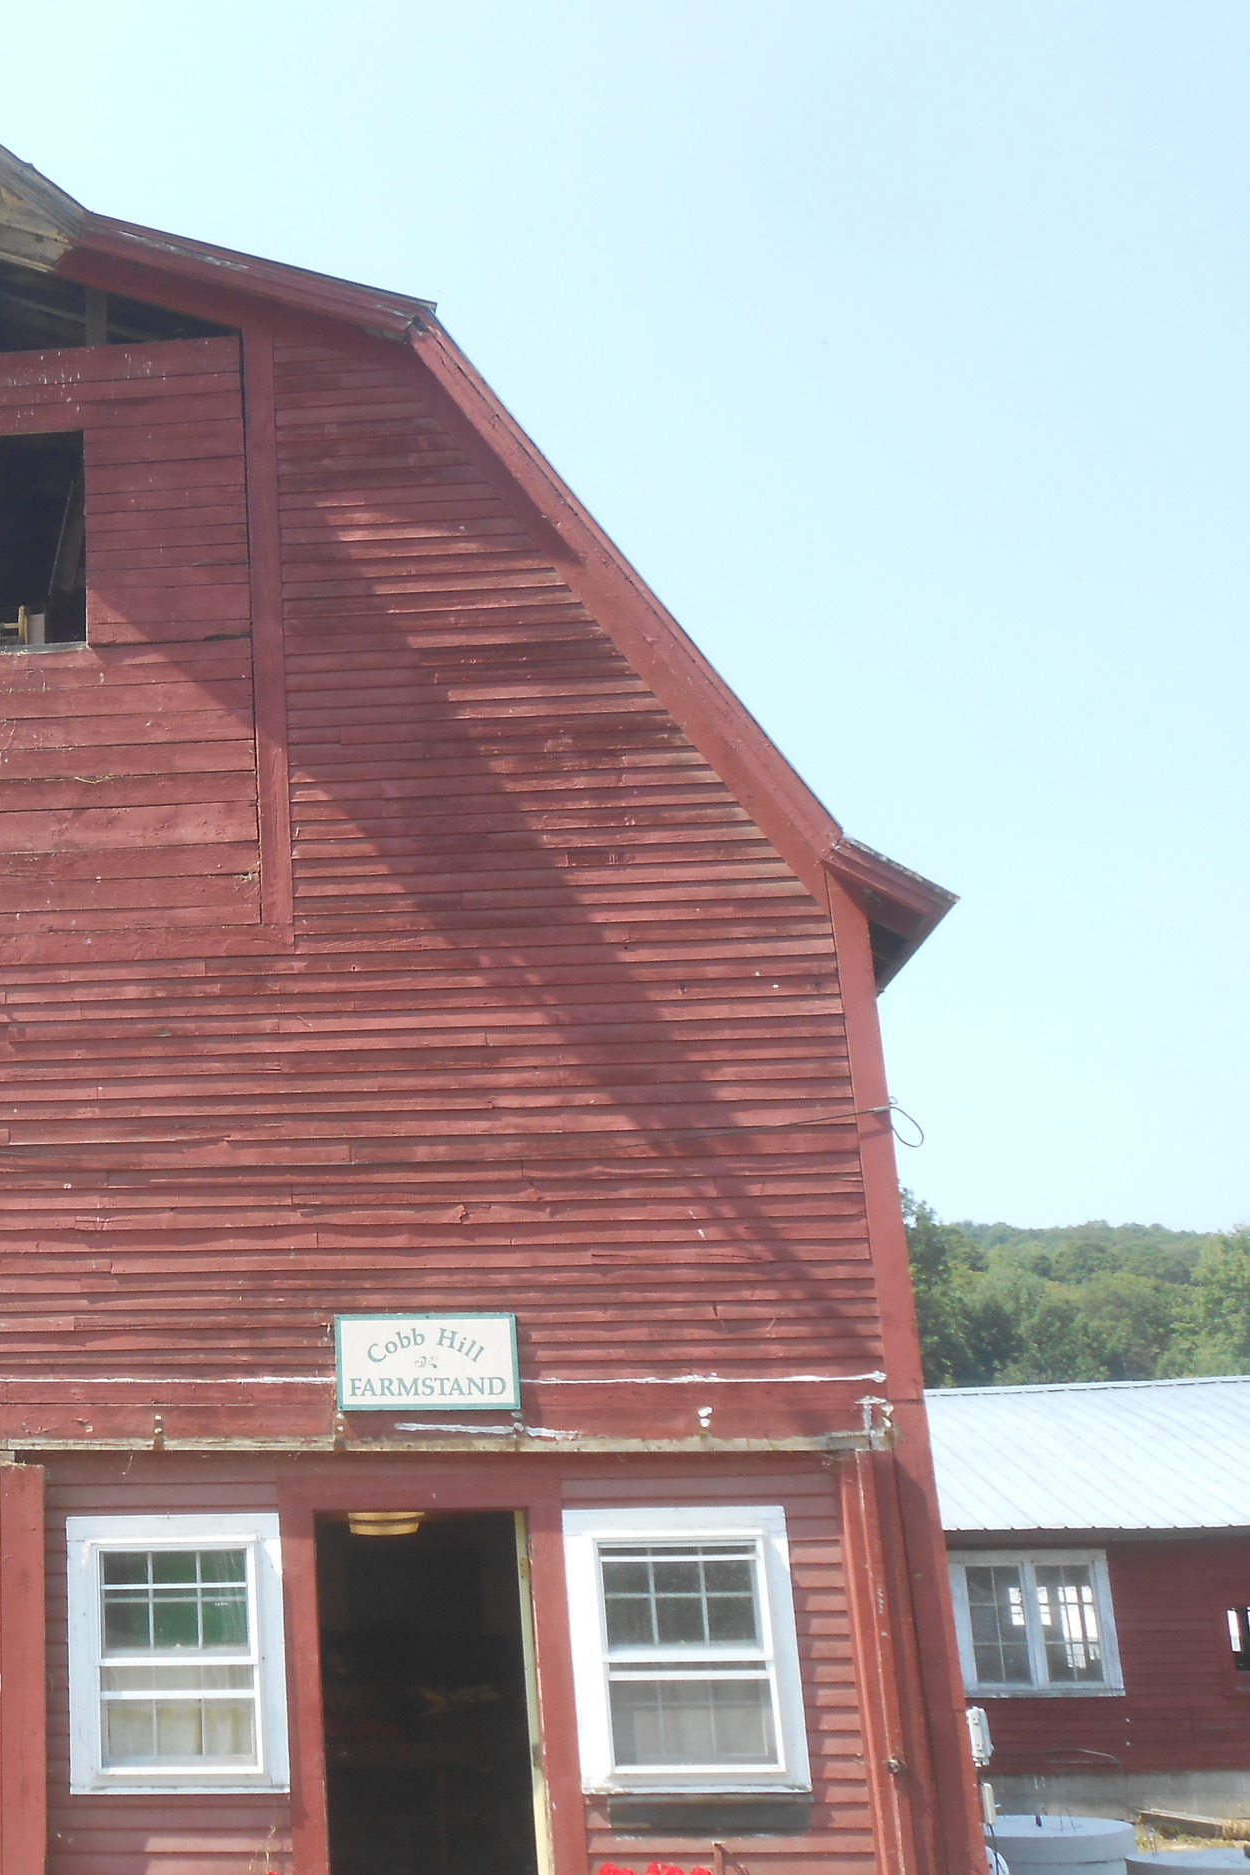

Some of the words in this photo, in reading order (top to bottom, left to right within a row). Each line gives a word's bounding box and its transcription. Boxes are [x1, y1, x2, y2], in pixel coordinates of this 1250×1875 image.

[367, 1327, 425, 1363] Cobb
[436, 1327, 485, 1363] Hill
[349, 1376, 507, 1397] FARMSTAND
